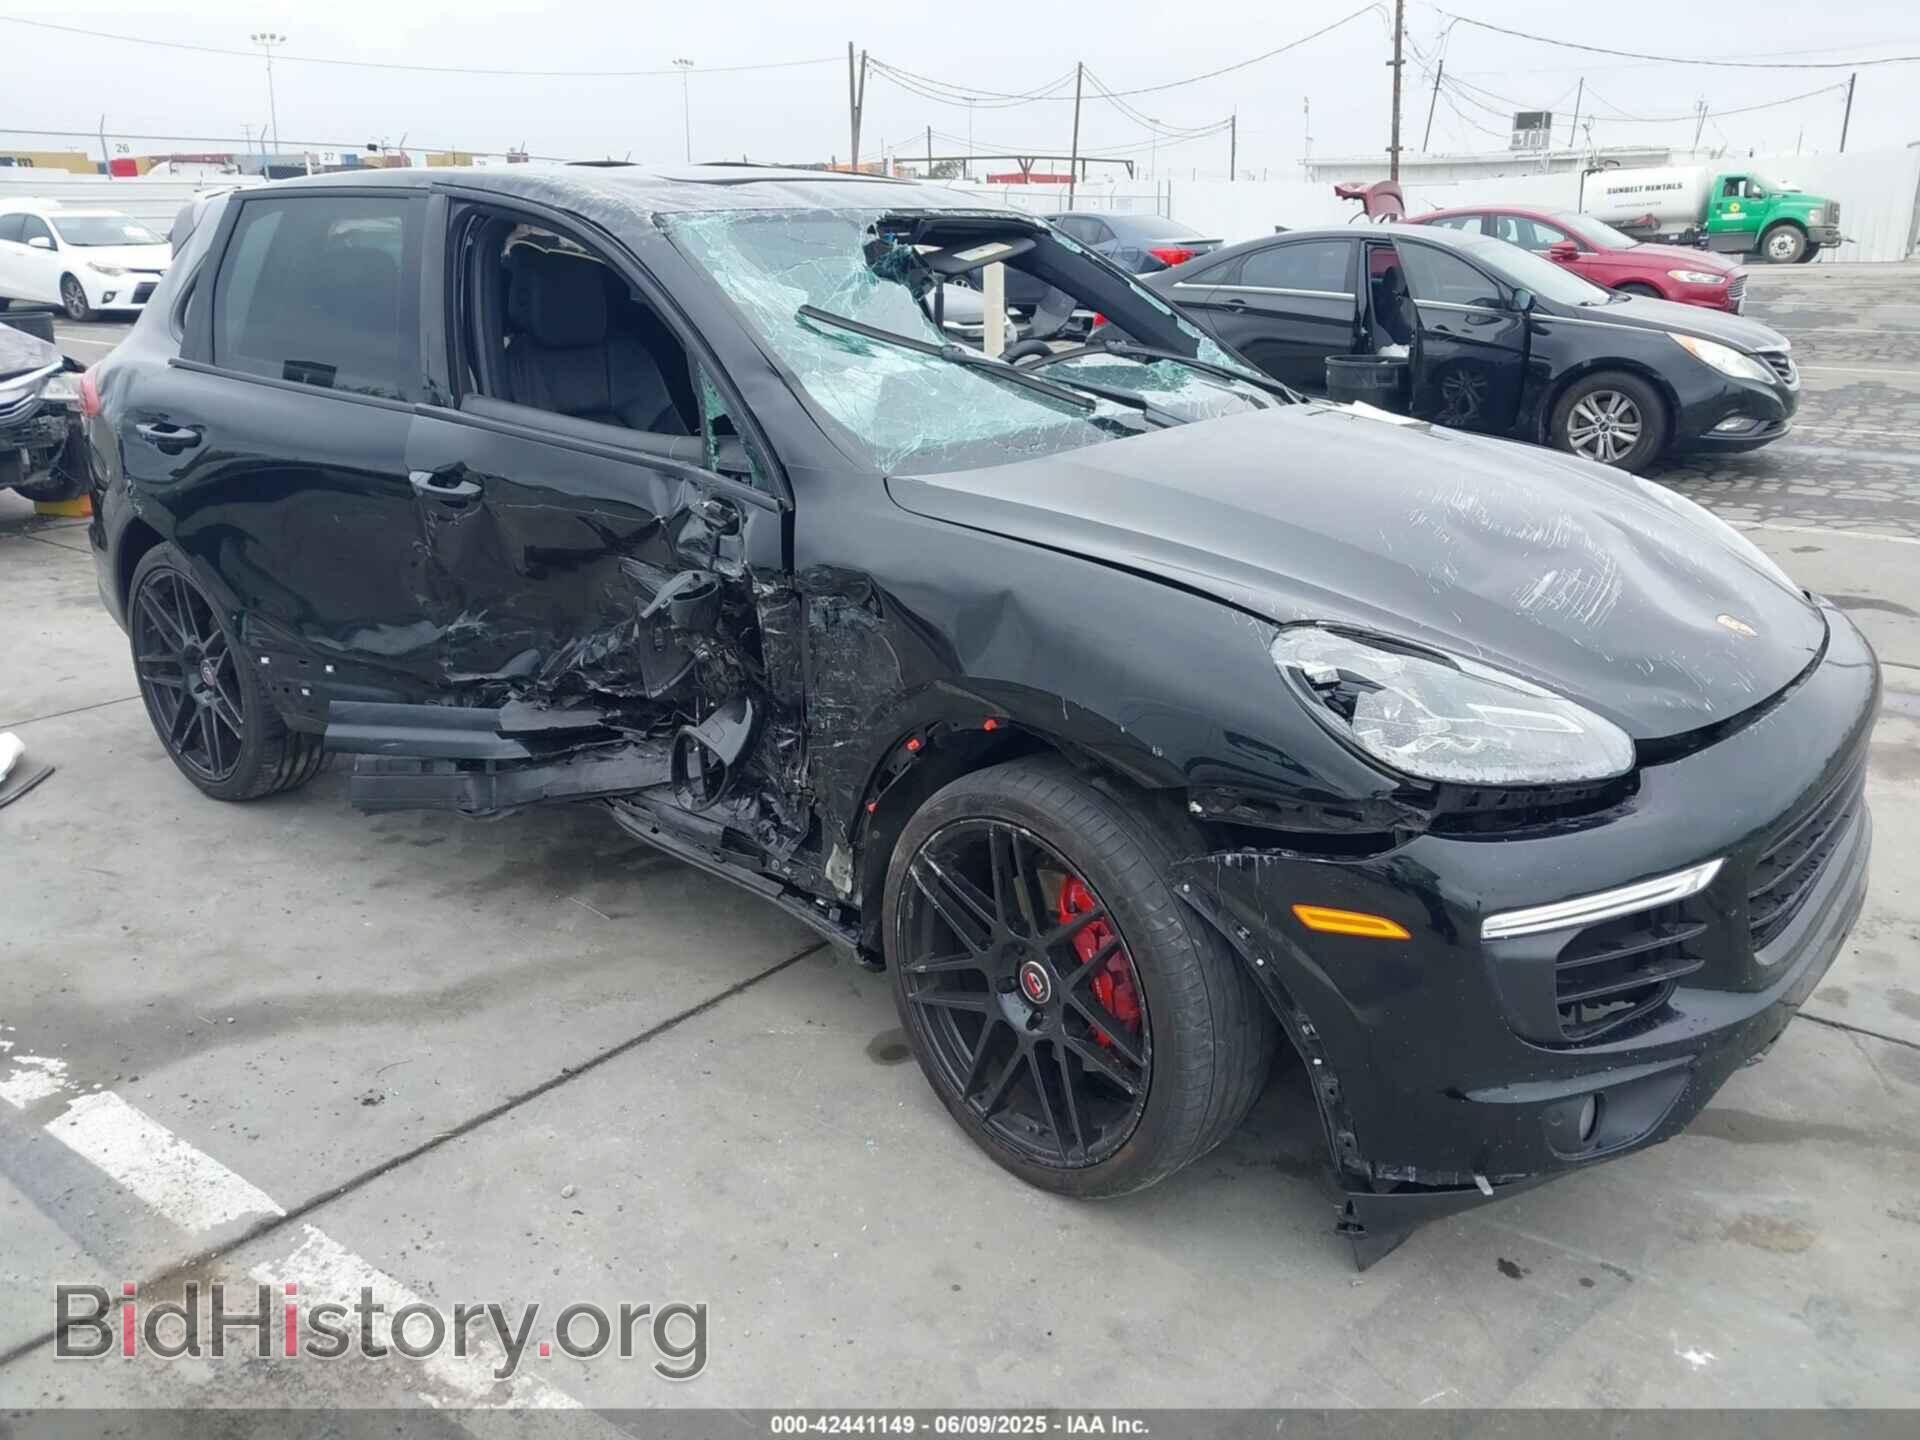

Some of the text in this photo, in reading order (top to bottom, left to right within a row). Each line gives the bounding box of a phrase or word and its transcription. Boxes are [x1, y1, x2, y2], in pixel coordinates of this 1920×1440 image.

[115, 143, 130, 153] 26
[324, 152, 335, 161] 27
[1645, 182, 1683, 192] RENTALS
